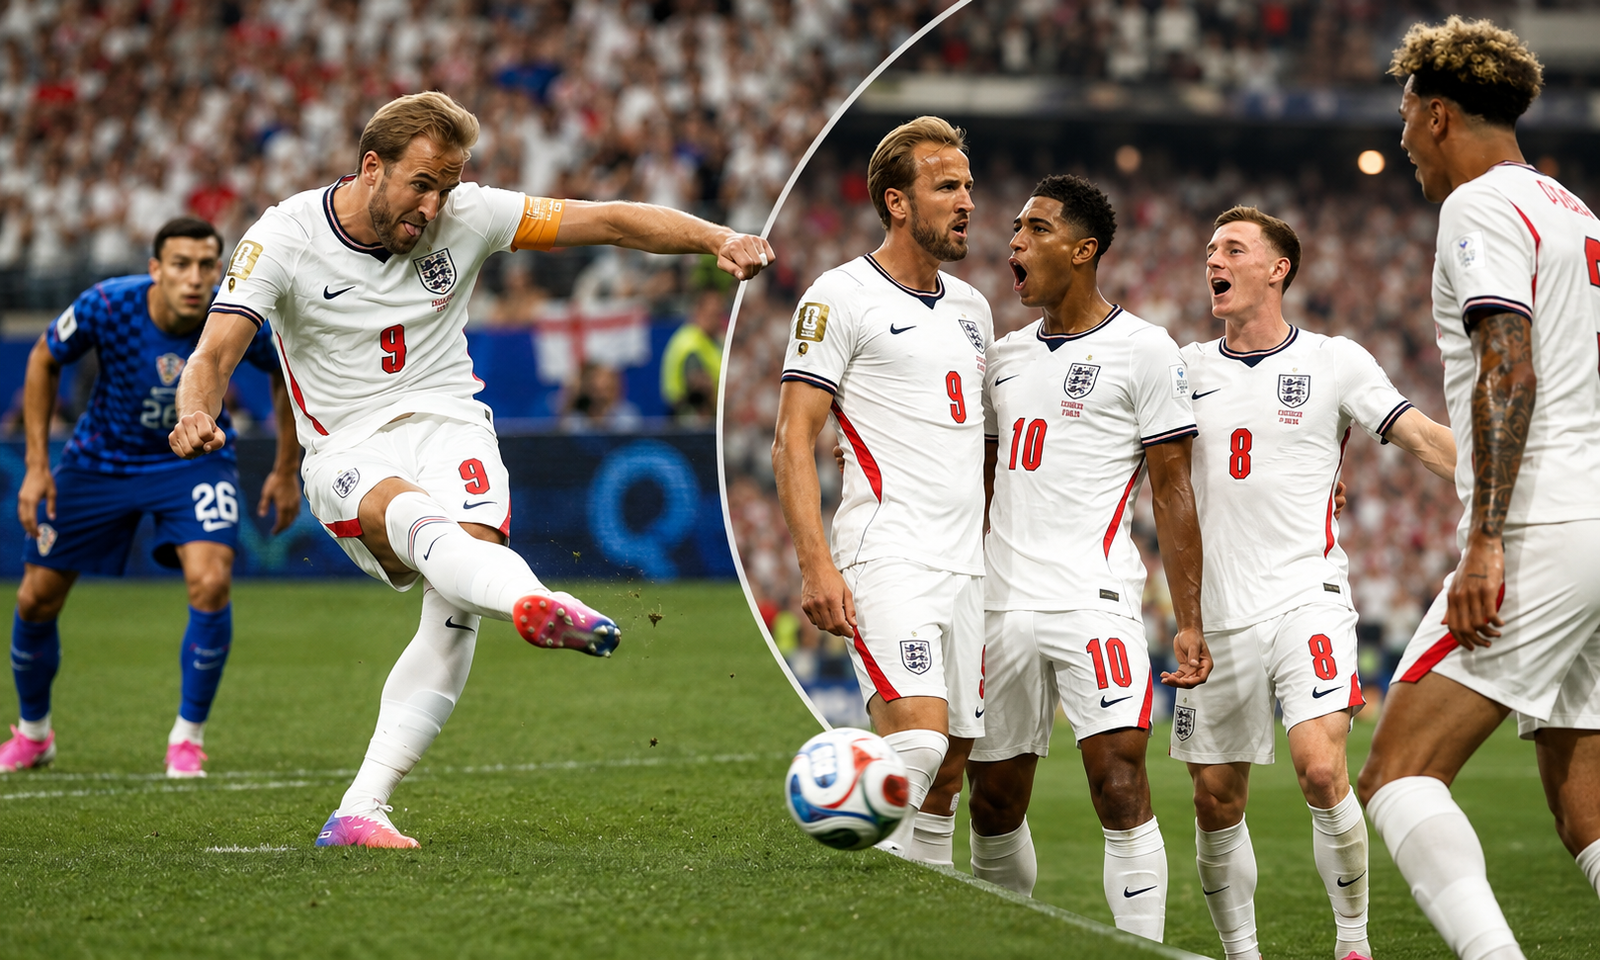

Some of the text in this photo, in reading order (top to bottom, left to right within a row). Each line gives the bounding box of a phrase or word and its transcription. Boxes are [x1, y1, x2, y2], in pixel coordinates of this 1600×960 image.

[380, 324, 407, 374] 9
[945, 370, 967, 424] 9
[1008, 417, 1048, 472] 10
[1229, 428, 1253, 480] 8
[458, 457, 491, 495] 9
[192, 481, 238, 523] 26
[1085, 637, 1132, 690] 10
[1308, 633, 1338, 681] 8
